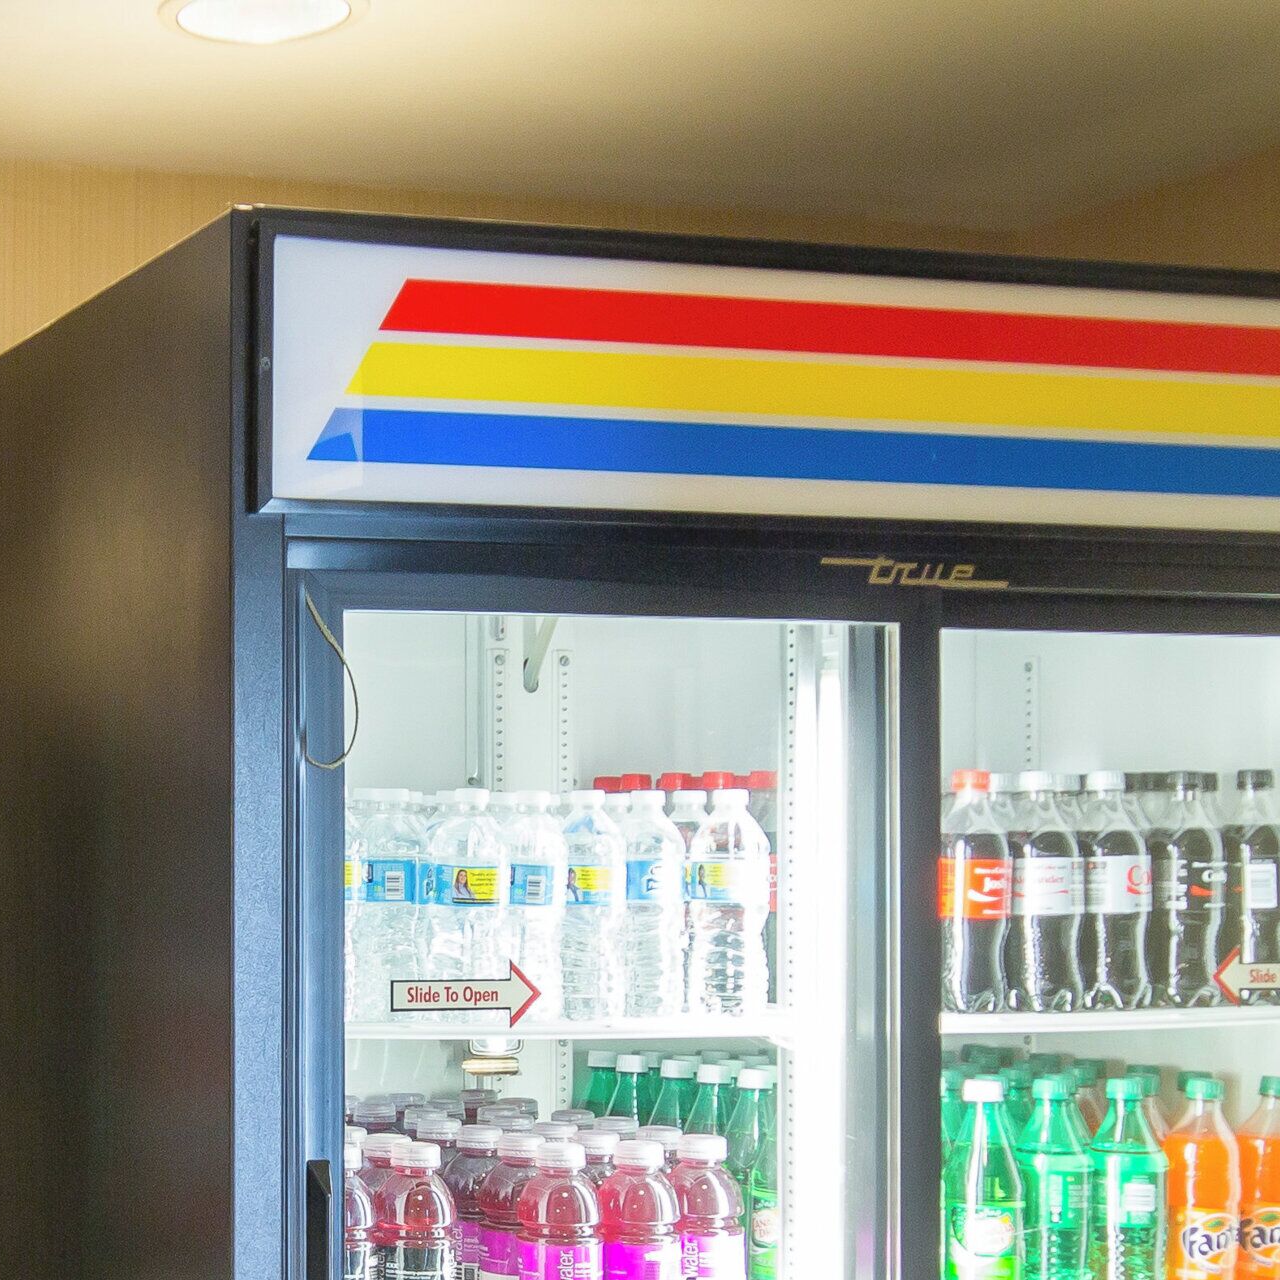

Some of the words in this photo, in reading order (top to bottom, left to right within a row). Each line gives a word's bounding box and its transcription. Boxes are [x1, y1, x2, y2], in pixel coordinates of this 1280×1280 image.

[1249, 969, 1277, 983] Slide
[406, 986, 440, 1004] Slide
[444, 986, 460, 1003] To
[463, 985, 499, 1006] Open
